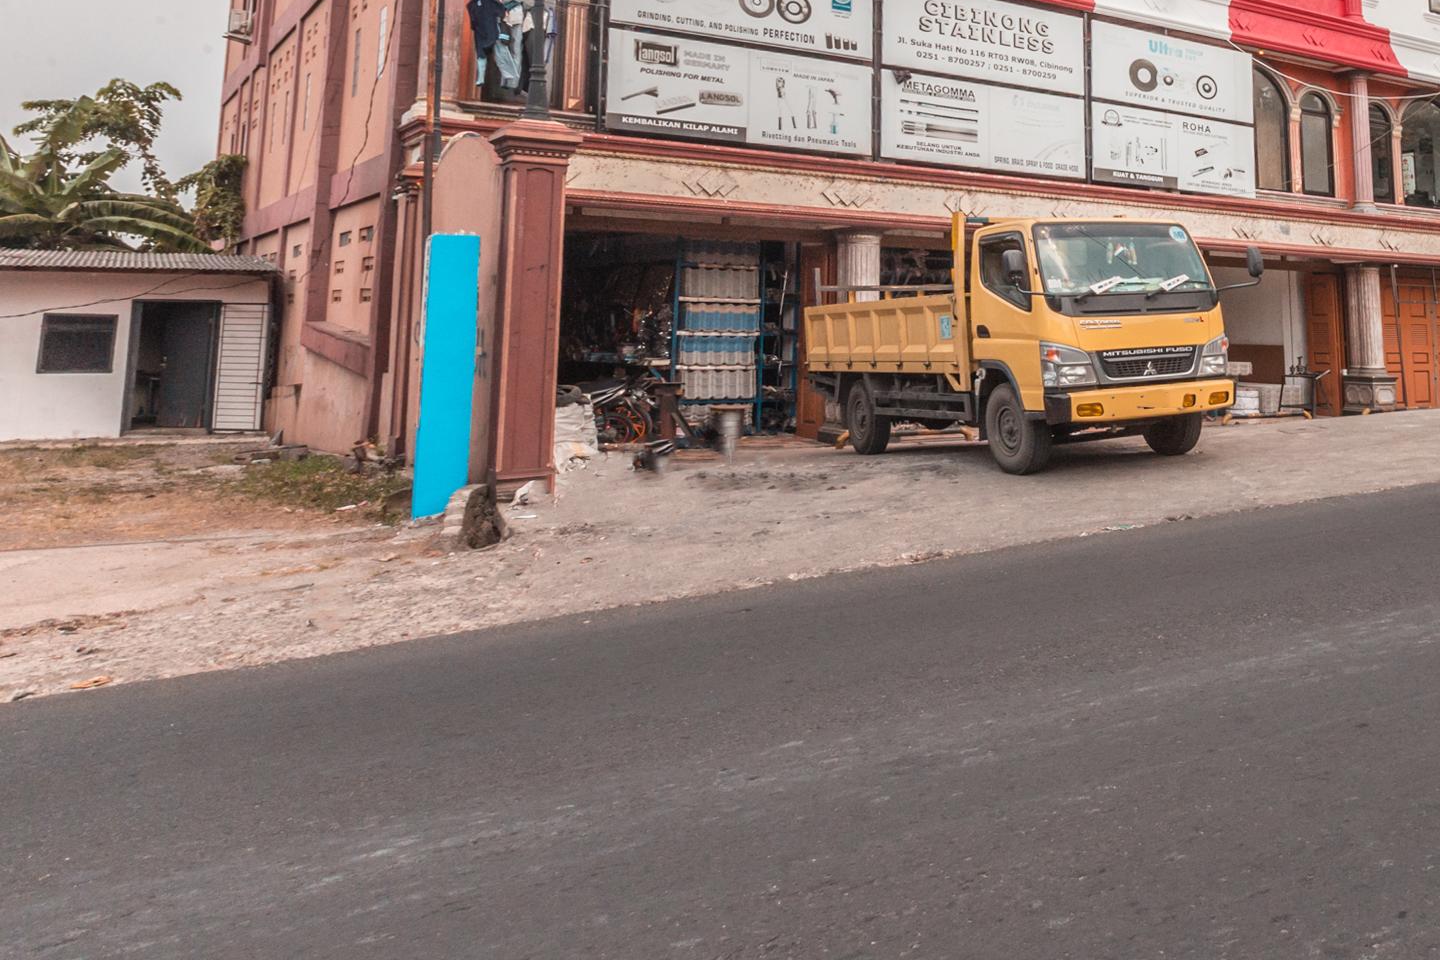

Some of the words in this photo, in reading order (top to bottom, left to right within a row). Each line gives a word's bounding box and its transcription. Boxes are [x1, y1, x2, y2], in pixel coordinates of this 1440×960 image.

[924, 0, 1050, 37] CIBINONG
[709, 21, 723, 30] AND
[724, 23, 759, 36] POLISHING
[762, 27, 815, 45] PERFECTION
[918, 16, 1055, 55] STAINLESS
[910, 38, 933, 49] Suka
[935, 42, 953, 52] Hati
[955, 46, 967, 55] No
[988, 52, 1009, 62] RT03
[1039, 60, 1073, 74] Cibinong
[916, 50, 939, 61] 0251
[947, 55, 986, 68] 8700257
[993, 63, 1014, 73] 0251
[1022, 68, 1057, 80] 8700259
[640, 67, 681, 79] POLISHING
[700, 75, 725, 84] METAL
[903, 80, 976, 98] METAGOMMA
[1125, 90, 1158, 101] SUPERIOR
[1168, 98, 1197, 108] TRUSTED
[1199, 104, 1226, 113] QUALITY
[621, 116, 681, 129] KEMBALIKAN
[683, 123, 709, 132] KILAP
[710, 126, 739, 135] ALAMI
[1182, 121, 1211, 133] ROHA
[1102, 348, 1164, 357] MITSUBISHI
